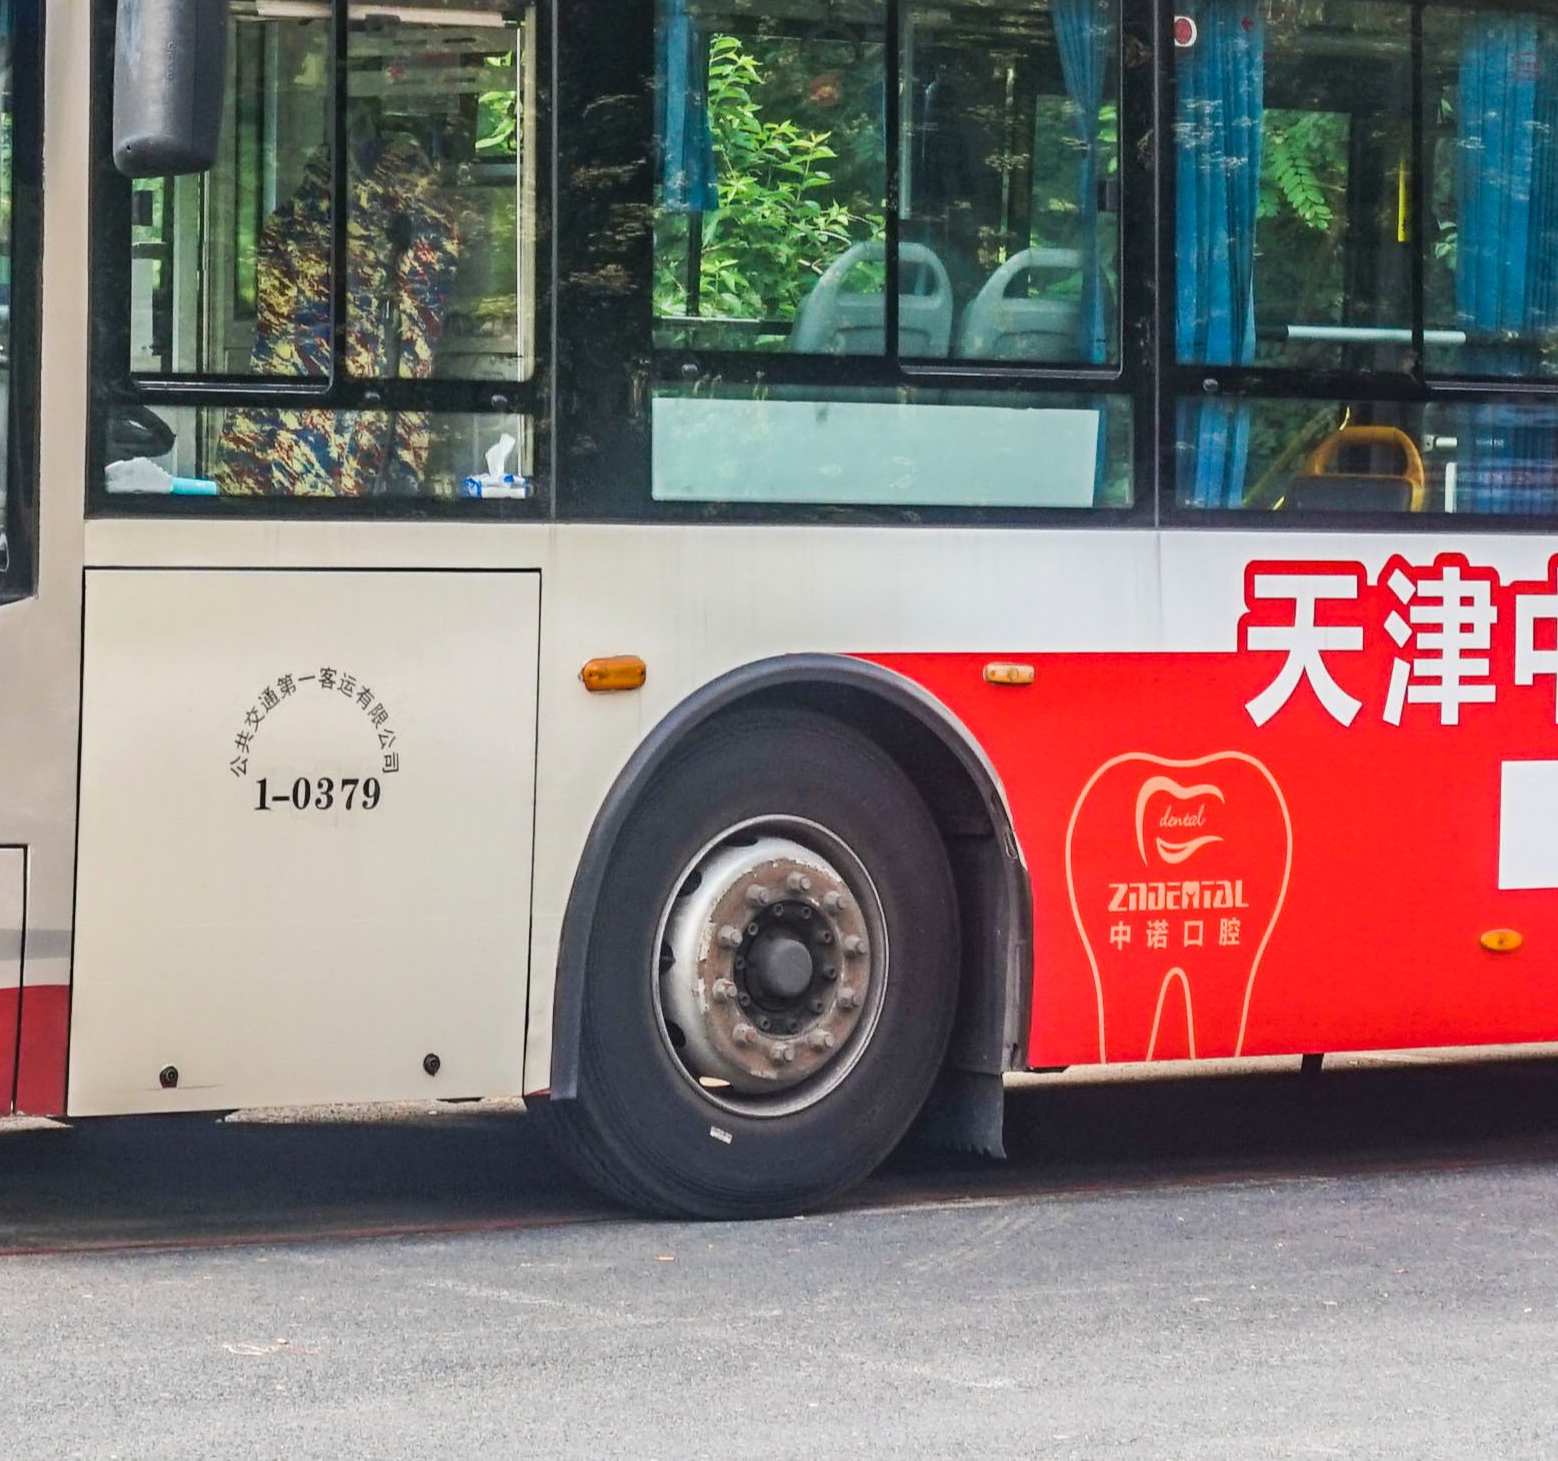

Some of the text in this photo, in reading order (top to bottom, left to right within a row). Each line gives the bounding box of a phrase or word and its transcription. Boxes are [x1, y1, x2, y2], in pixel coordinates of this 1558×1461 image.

[229, 666, 399, 778] 公共交通第一客运有限公司
[254, 777, 381, 811] 1-0379
[1159, 804, 1206, 828] dental
[1108, 916, 1242, 951] 中诺口腔
